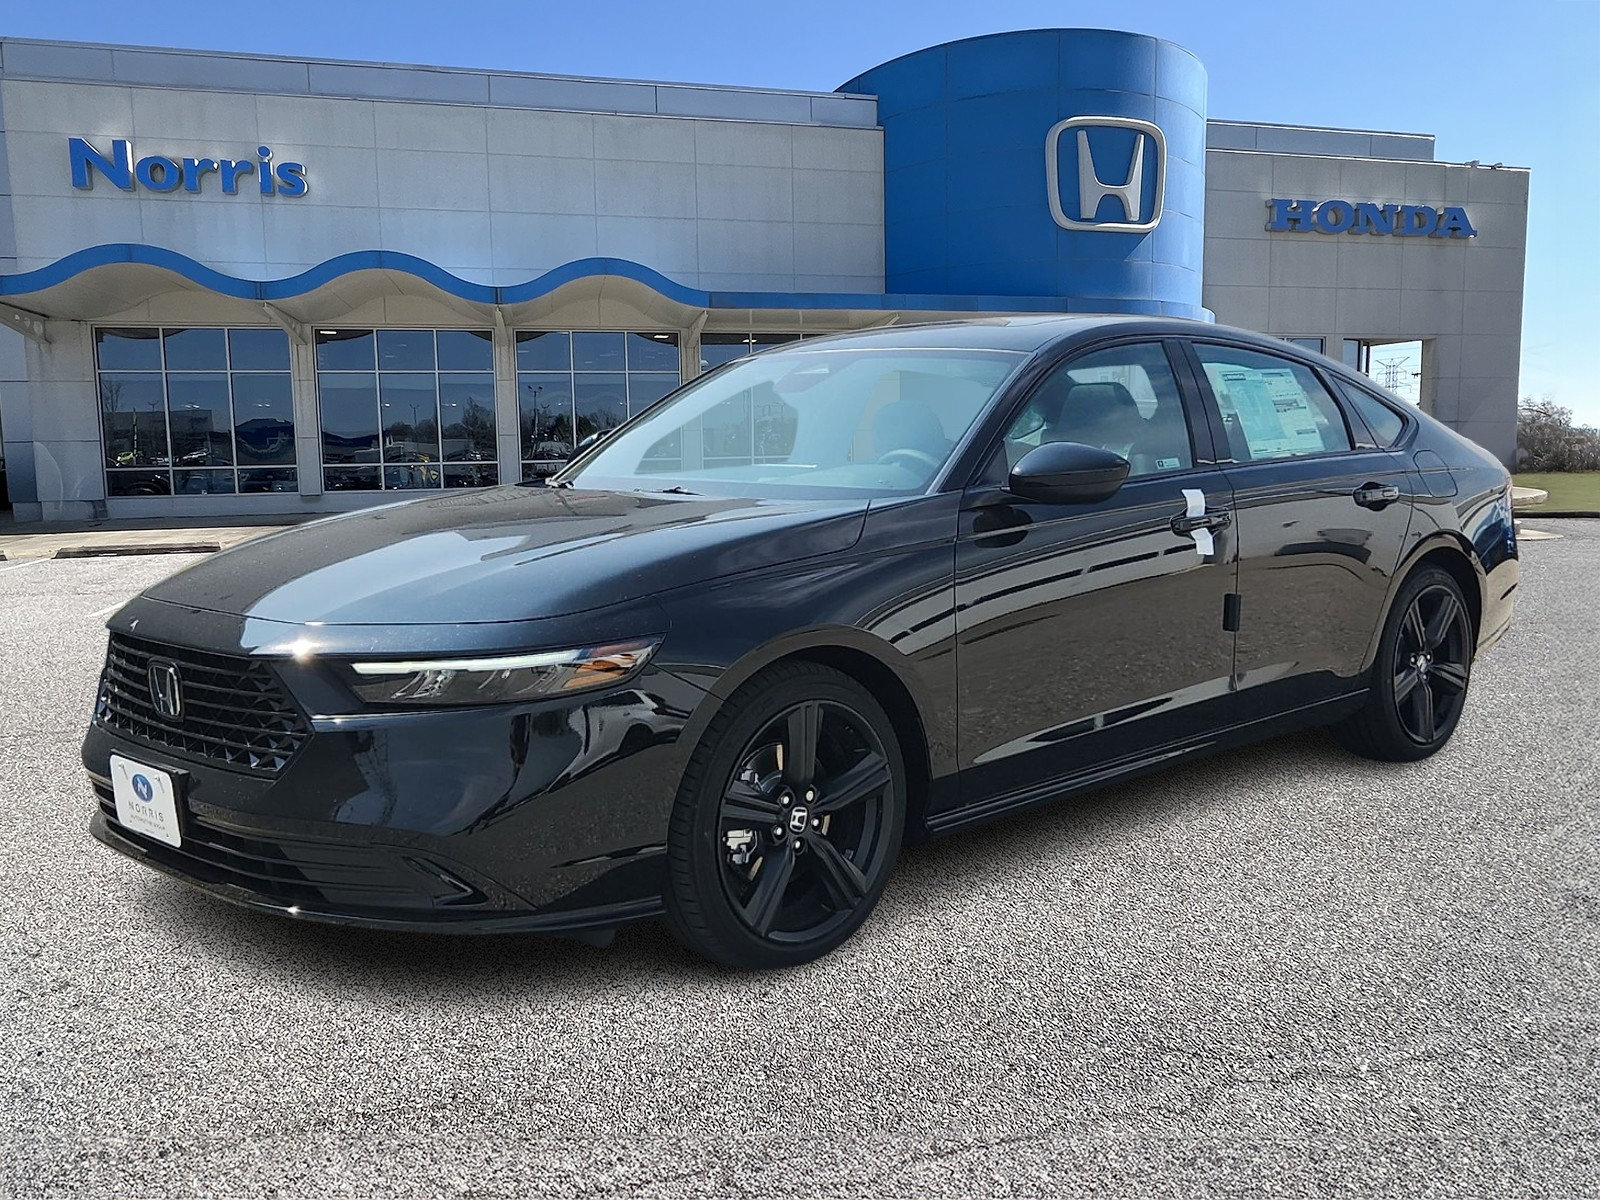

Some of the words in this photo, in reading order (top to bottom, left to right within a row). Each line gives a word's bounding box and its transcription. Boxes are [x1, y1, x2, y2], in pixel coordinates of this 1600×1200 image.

[68, 137, 309, 197] Norris
[1265, 198, 1477, 239] HONDA
[128, 801, 164, 822] NORRIS
